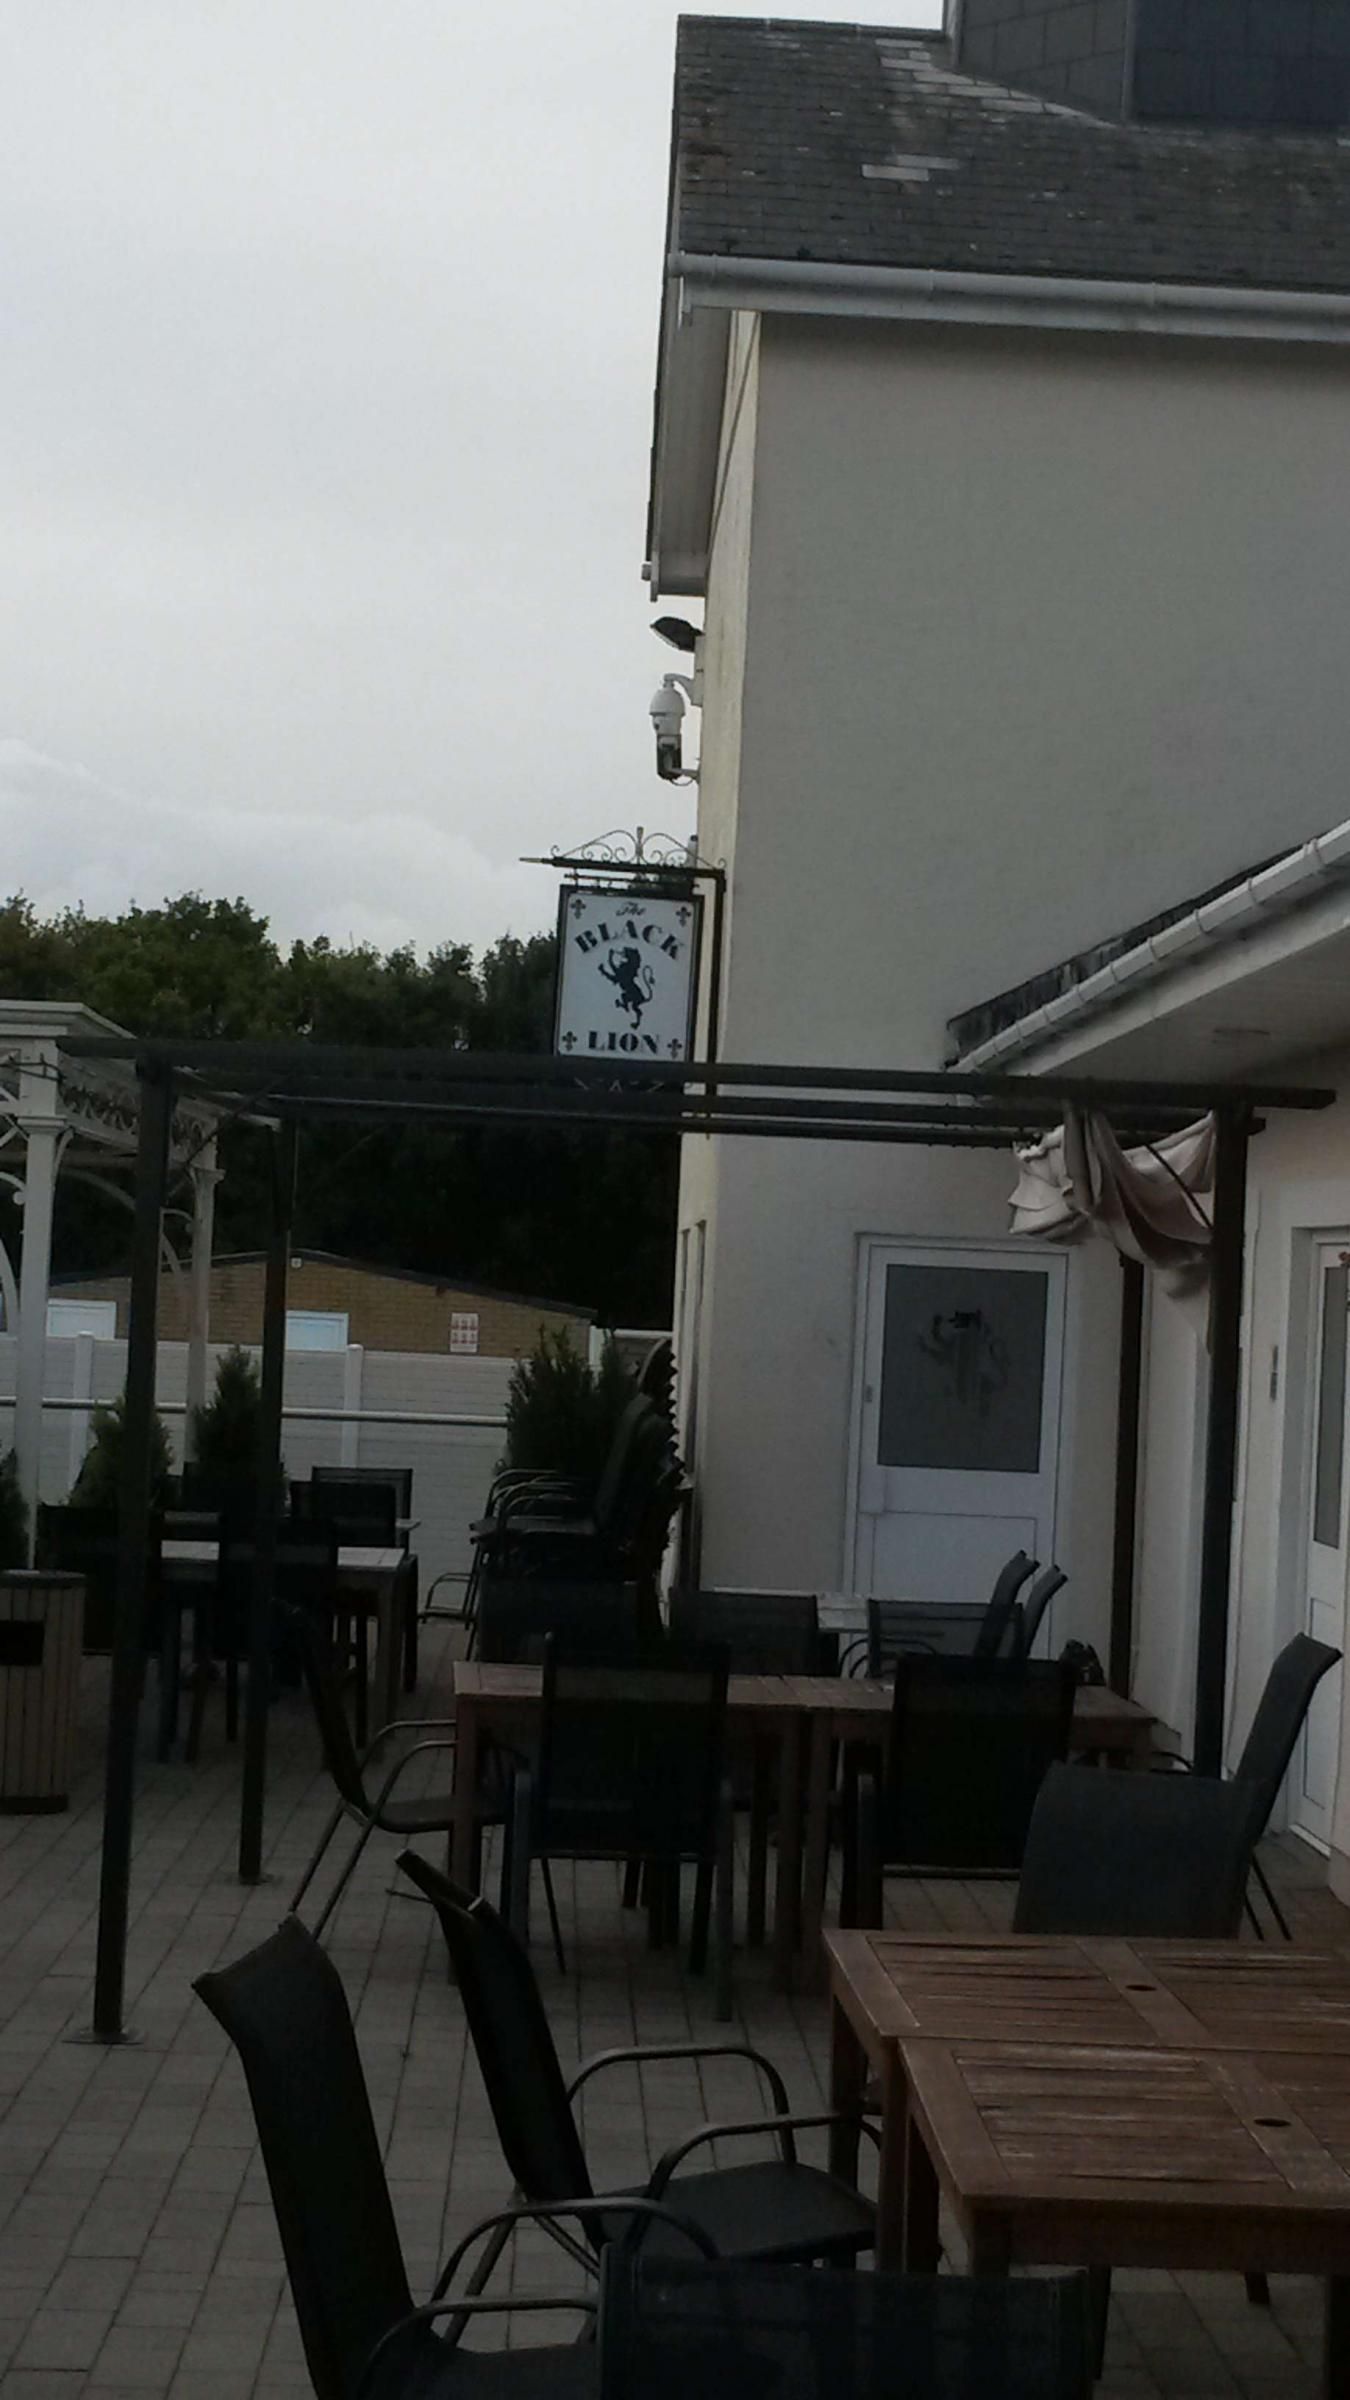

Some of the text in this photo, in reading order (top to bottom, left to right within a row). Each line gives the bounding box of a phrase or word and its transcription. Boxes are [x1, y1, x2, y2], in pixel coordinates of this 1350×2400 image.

[616, 902, 646, 917] The
[575, 920, 685, 960] BLACK
[588, 1031, 660, 1054] LION
